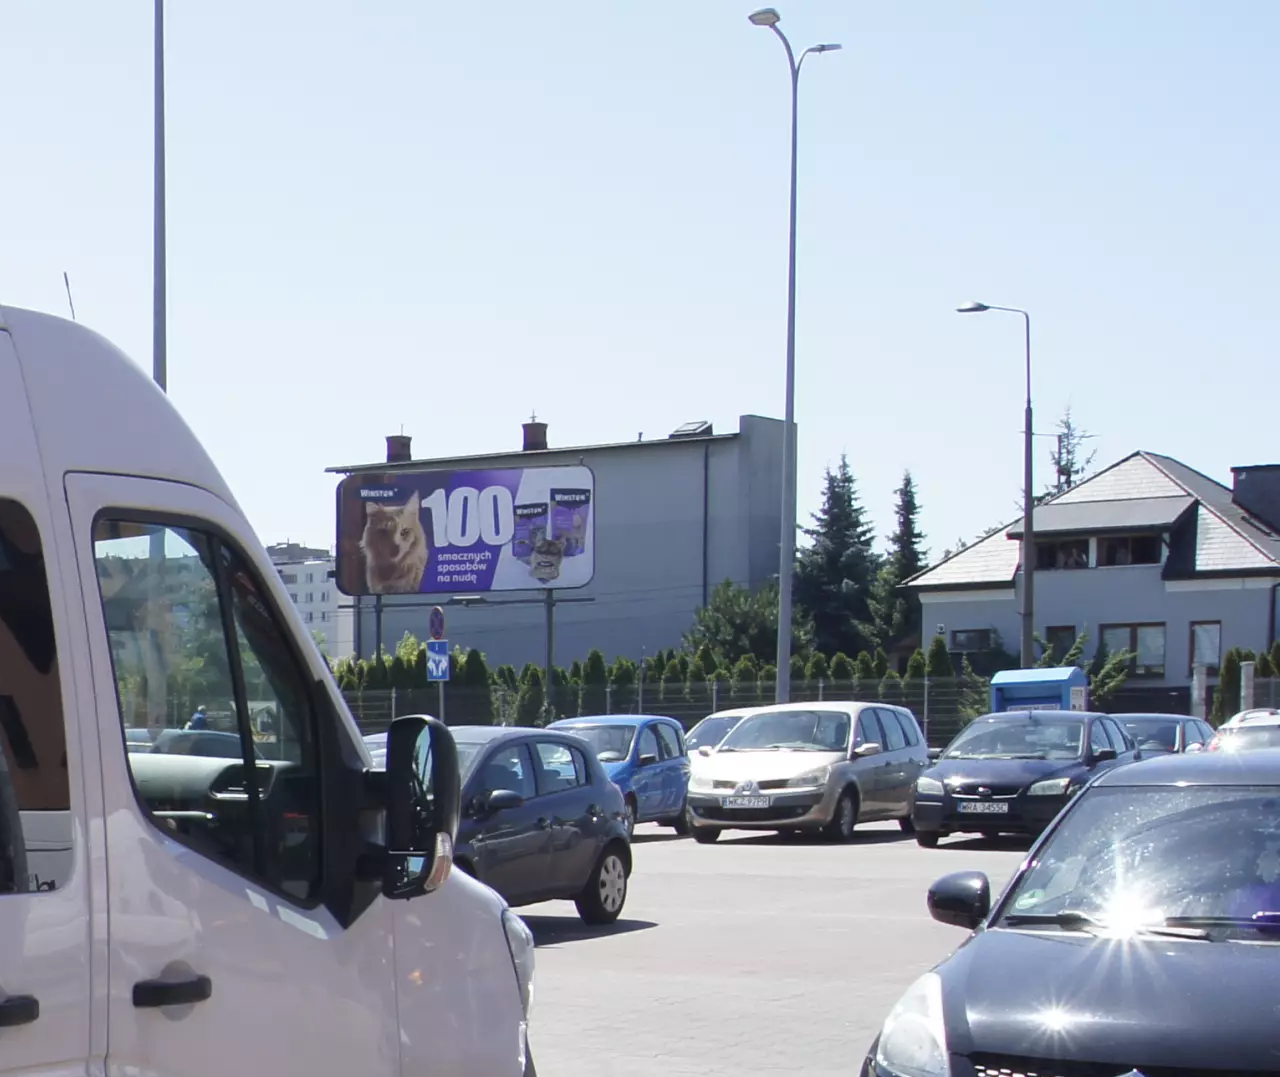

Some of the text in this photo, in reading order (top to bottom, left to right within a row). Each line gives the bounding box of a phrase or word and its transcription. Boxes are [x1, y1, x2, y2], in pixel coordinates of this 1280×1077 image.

[421, 485, 514, 547] 100
[437, 550, 492, 563] smacznych
[437, 561, 487, 573] sposobów
[452, 572, 477, 584] nudę
